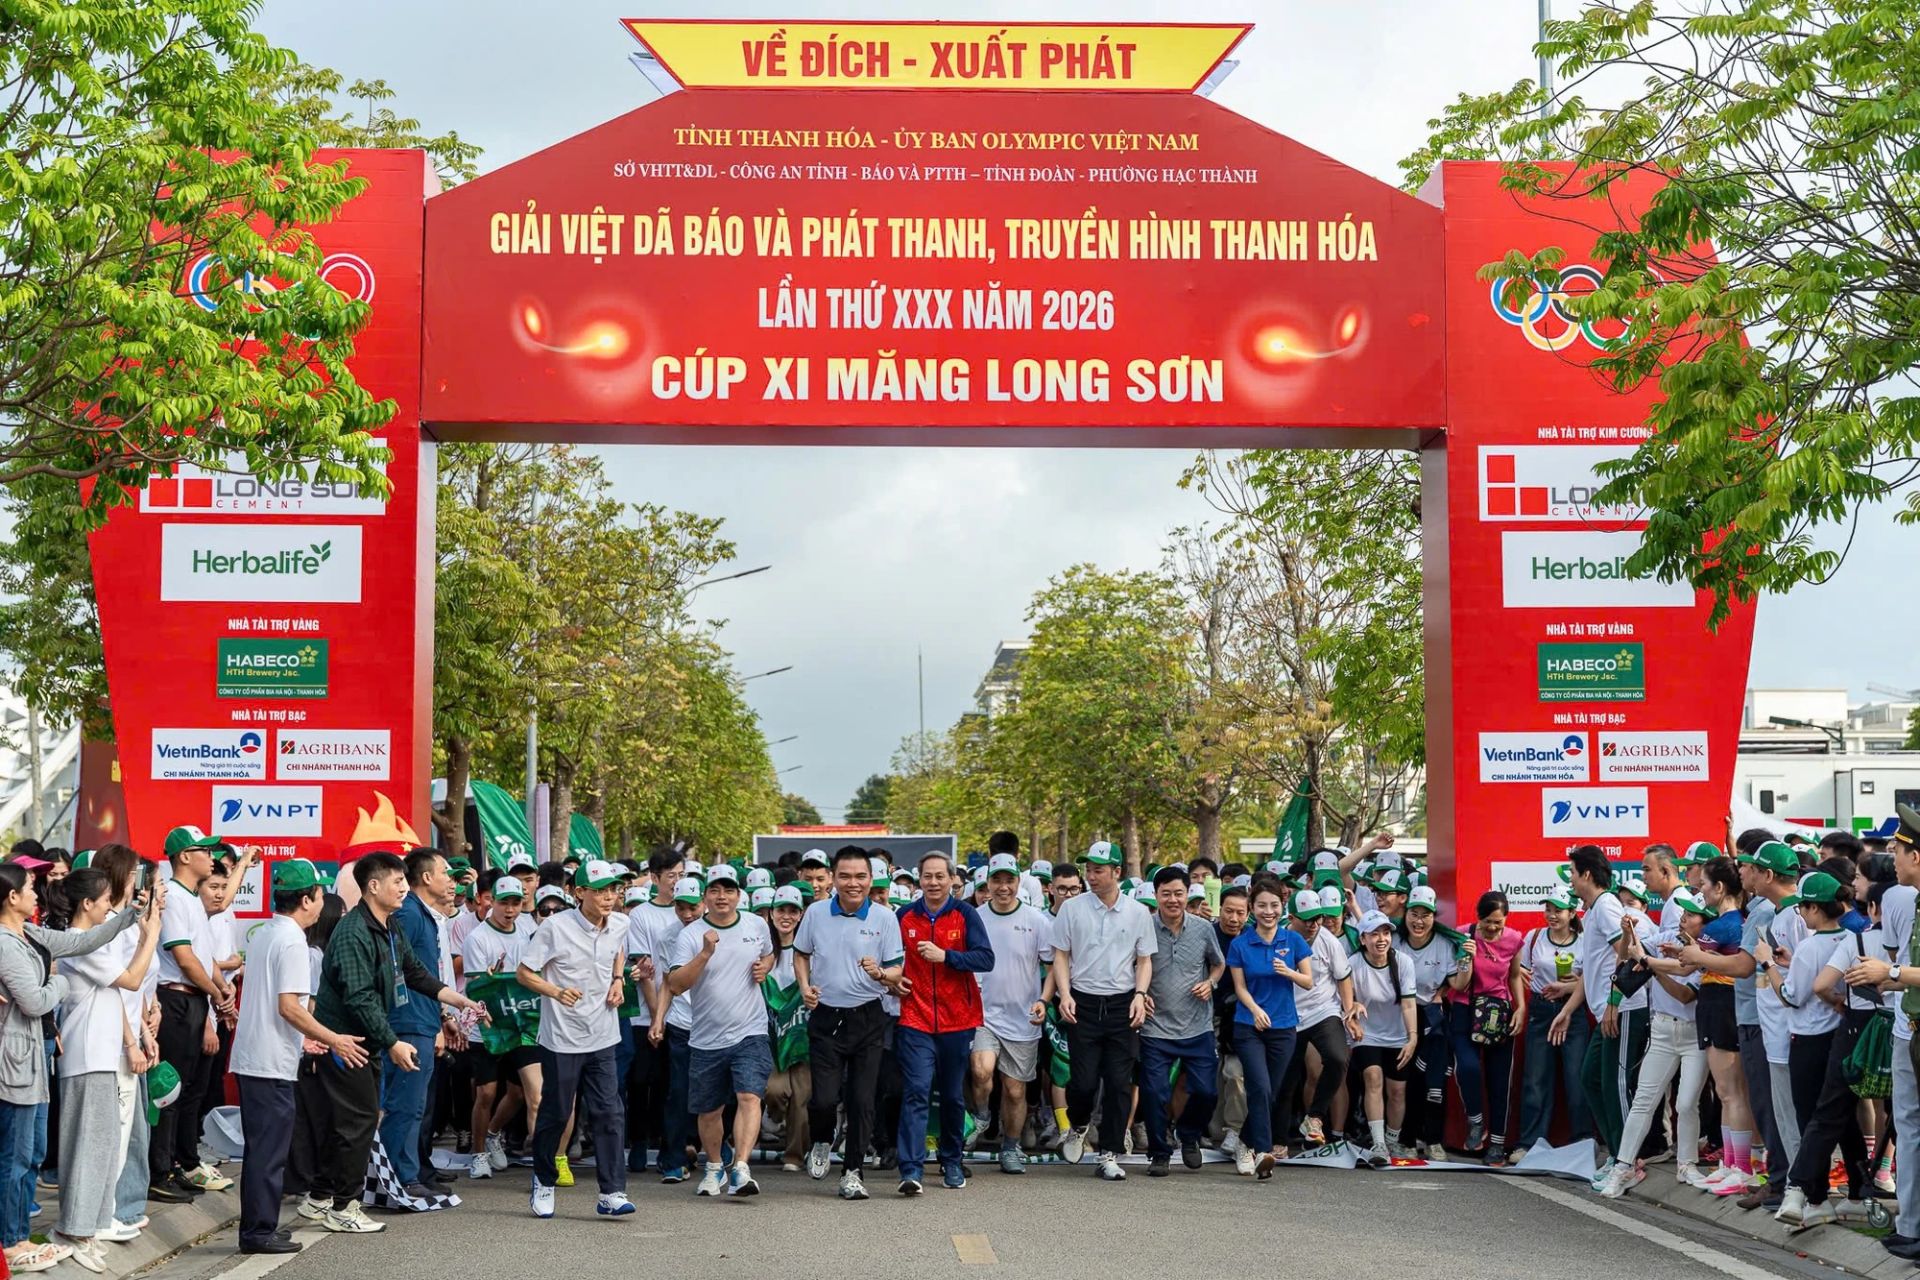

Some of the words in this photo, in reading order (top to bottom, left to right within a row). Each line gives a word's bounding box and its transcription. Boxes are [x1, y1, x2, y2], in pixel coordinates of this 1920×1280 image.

[742, 29, 787, 77] VỀ
[800, 34, 890, 78] ĐÍCH
[904, 58, 917, 67] -
[930, 29, 1028, 80] XUẤT
[1041, 33, 1137, 80] PHÁT
[674, 124, 732, 145] TỈNH
[737, 130, 819, 147] THANH
[826, 127, 876, 148] HÓA
[894, 128, 925, 148] ỦY
[930, 132, 976, 148] BAN
[982, 133, 1085, 150] OLYMPIC
[1090, 130, 1142, 154] VIỆT
[1147, 134, 1198, 150] NAM
[614, 160, 635, 177] SỞ
[638, 164, 717, 178] VHTT&DL
[730, 161, 775, 178] CÔNG
[780, 166, 802, 179] AN
[806, 162, 847, 179] TỈNH
[861, 163, 894, 180] BÁO
[898, 163, 920, 180] VÀ
[924, 167, 966, 180] PTTH
[984, 164, 1025, 181] TỈNH
[1029, 165, 1075, 181] ĐOÀN
[1089, 165, 1158, 182] PHƯỜNG
[1162, 169, 1195, 185] HẠC
[1199, 166, 1257, 183] THÀNH
[491, 200, 550, 253] GIẢI
[561, 206, 624, 263] VIỆT
[635, 207, 674, 255] DÃ
[685, 208, 743, 256] BÁO
[754, 208, 792, 256] VÀ
[803, 209, 878, 257] PHÁT
[888, 218, 995, 263] THANH,
[1005, 206, 1119, 259] TRUYỀN
[1130, 211, 1200, 259] HÌNH
[1210, 221, 1307, 260] THANH
[1318, 213, 1377, 261] HÓA
[759, 274, 816, 328] LẦN
[826, 280, 886, 329] THỨ
[893, 289, 952, 328] XXX
[963, 281, 1031, 329] NĂM
[1043, 290, 1114, 330] 2026
[652, 348, 746, 399] CÚP
[764, 358, 808, 399] XI
[828, 350, 968, 401] MĂNG
[988, 359, 1108, 401] LONG
[1127, 356, 1222, 401] SƠN
[1537, 425, 1559, 439] NHÀ
[1560, 425, 1576, 439] TÀI
[1577, 426, 1597, 441] TRỢ
[1598, 427, 1618, 439] KIM
[215, 500, 303, 509] CEMENT
[1552, 507, 1635, 516] CEMENT
[193, 550, 320, 574] Herbalife
[1533, 557, 1652, 580] Herbali
[228, 616, 250, 630] NHÀ
[251, 616, 268, 631] TÀI
[270, 618, 291, 633] TRỢ
[291, 617, 320, 631] VÀNG
[1546, 622, 1568, 636] NHÀ
[1568, 622, 1585, 636] TÀI
[1586, 622, 1606, 638] TRỢ
[1607, 621, 1634, 635] VÀNG
[227, 654, 300, 668] HABECO
[1547, 659, 1617, 671] HABECO
[226, 668, 245, 676] HTH
[247, 668, 281, 678] Brewery
[283, 668, 301, 677] Jsc.
[1547, 672, 1565, 681] HTH
[1566, 672, 1599, 682] Brewery
[1601, 672, 1618, 680] Jsc.
[231, 708, 251, 721] NHÀ
[252, 708, 268, 721] TÀI
[268, 709, 287, 723] TRỢ
[287, 710, 307, 723] BẠC
[1553, 712, 1573, 724] NHÀ
[1573, 712, 1588, 724] TÀI
[1589, 712, 1607, 726] TRỢ
[1607, 713, 1626, 726] BẠC
[297, 743, 386, 756] AGRIBANK
[1619, 744, 1705, 757] AGRIBANK
[179, 770, 206, 778] NHÁNH
[233, 770, 250, 778] HÓA
[286, 763, 301, 771] CHI
[301, 763, 332, 771] NHÁNH
[332, 763, 362, 771] THANH
[362, 762, 381, 772] HÓA
[1609, 764, 1624, 773] CHI
[1624, 763, 1653, 773] NHÁNH
[1654, 764, 1681, 772] THANH
[1683, 763, 1701, 772] HÓA
[1506, 773, 1532, 781] NHÁNH
[1558, 772, 1575, 780] HÓA
[247, 804, 319, 818] VNPT
[1576, 805, 1645, 819] VNPT
[263, 845, 277, 856] TÀI
[279, 845, 296, 858] TRỢ
[1606, 845, 1622, 858] TRỢ
[1498, 882, 1556, 895] Vietcom
